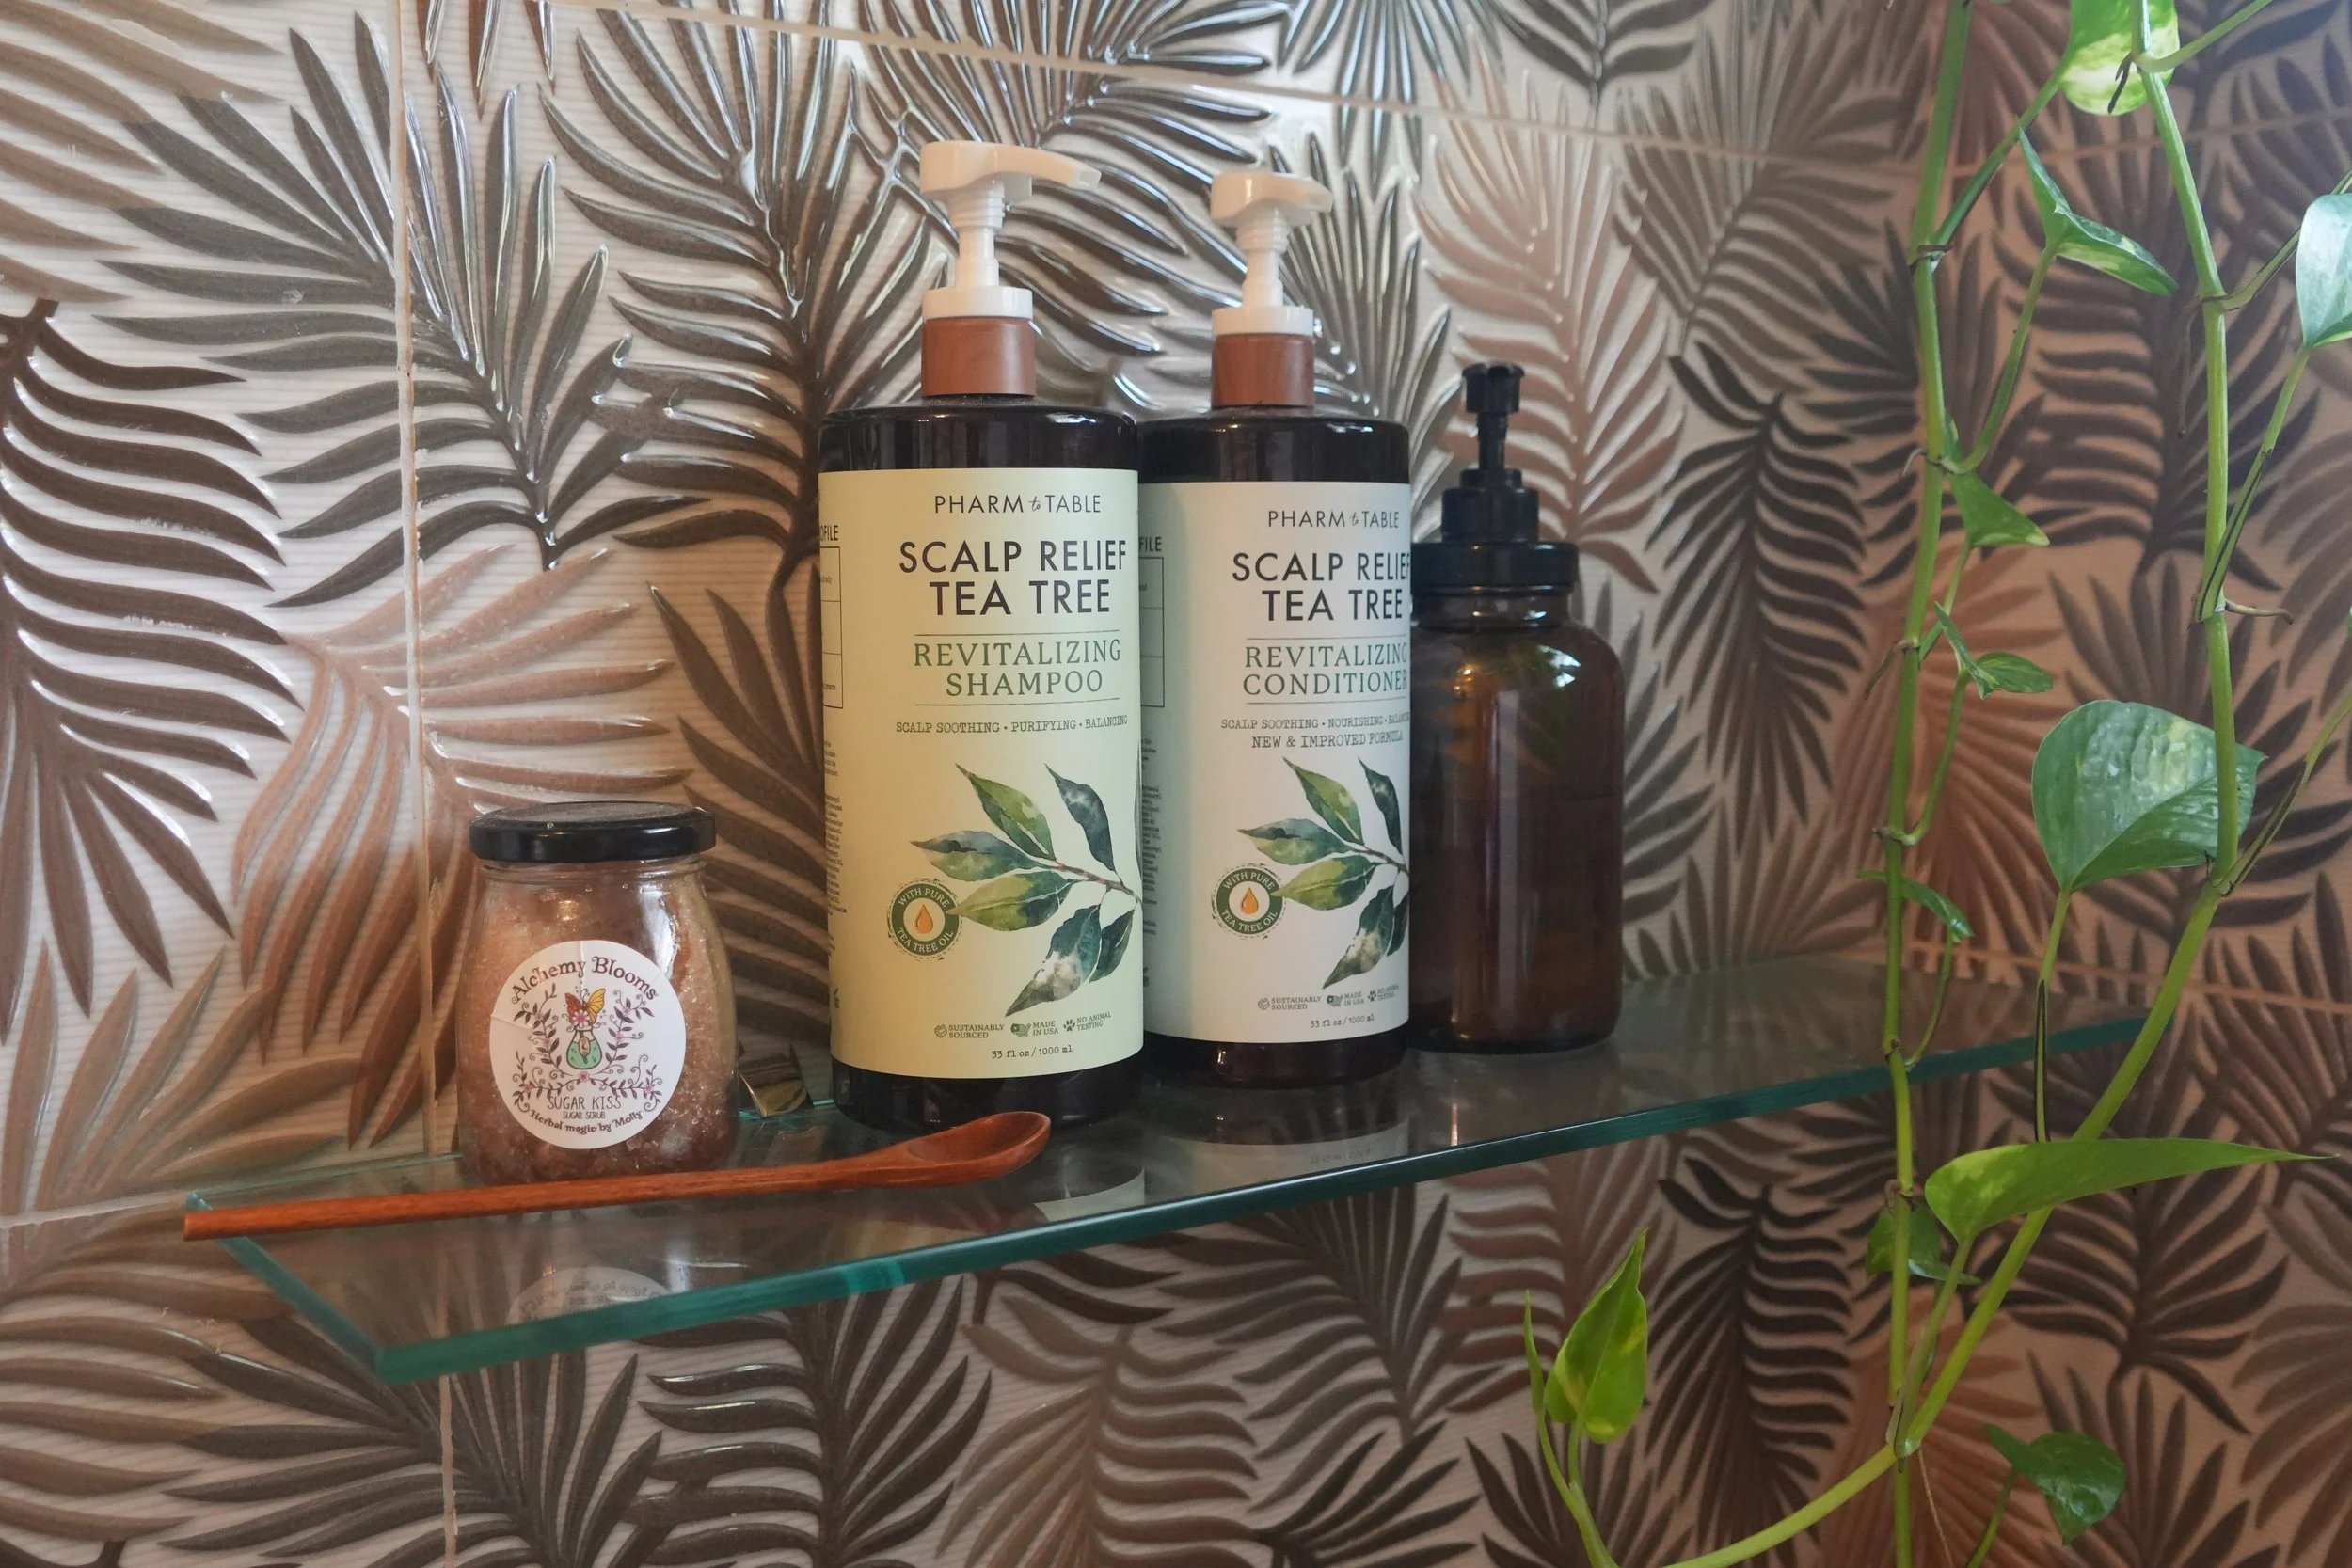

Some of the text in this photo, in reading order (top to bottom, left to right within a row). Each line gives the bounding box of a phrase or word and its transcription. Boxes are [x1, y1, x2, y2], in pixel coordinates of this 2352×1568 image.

[935, 495, 1101, 514] PHARM to TABLE
[1268, 510, 1399, 528] PHARM to TABLE
[899, 540, 1126, 573] SCALP RELIEF
[1232, 552, 1410, 581] SCALP RELIEF
[930, 579, 1110, 616] TEA TREE
[1262, 589, 1403, 621] TEA TREE
[914, 639, 1120, 667] REVITALIZING
[1245, 642, 1407, 668] REVITALIZING
[946, 670, 1103, 697] SHAMPOO
[1243, 670, 1407, 695] CONDITIONER
[896, 715, 1128, 733] SCALP SOOTHING PURIFYING BALANCING
[1221, 719, 1258, 729] SCALP
[1261, 719, 1318, 729] SOOTHING
[1327, 716, 1383, 728] NOURISHING
[1252, 736, 1281, 749] NEW
[1286, 736, 1296, 748] &
[1301, 733, 1365, 748] IMPROVED
[1223, 872, 1275, 890] WITH PURE
[898, 887, 950, 908] WITH PURE
[1221, 909, 1279, 932] TEA TREE OIL
[897, 927, 954, 953] TEA TREE OIL
[511, 956, 659, 1005] Alchemy Blooms
[1077, 1020, 1104, 1031] TESTING
[1089, 1011, 1111, 1022] ANIMAL
[948, 1023, 1005, 1032] SUSTAINABLY
[992, 1050, 1003, 1059] 33
[1006, 1049, 1016, 1058] fl
[1039, 1046, 1059, 1055] 1000
[1062, 1045, 1073, 1053] ml
[548, 1096, 621, 1110] SUGAR KISS
[530, 1110, 644, 1135] Herbal magic by Molly
[563, 1111, 606, 1119] SUGAR SCRUB
